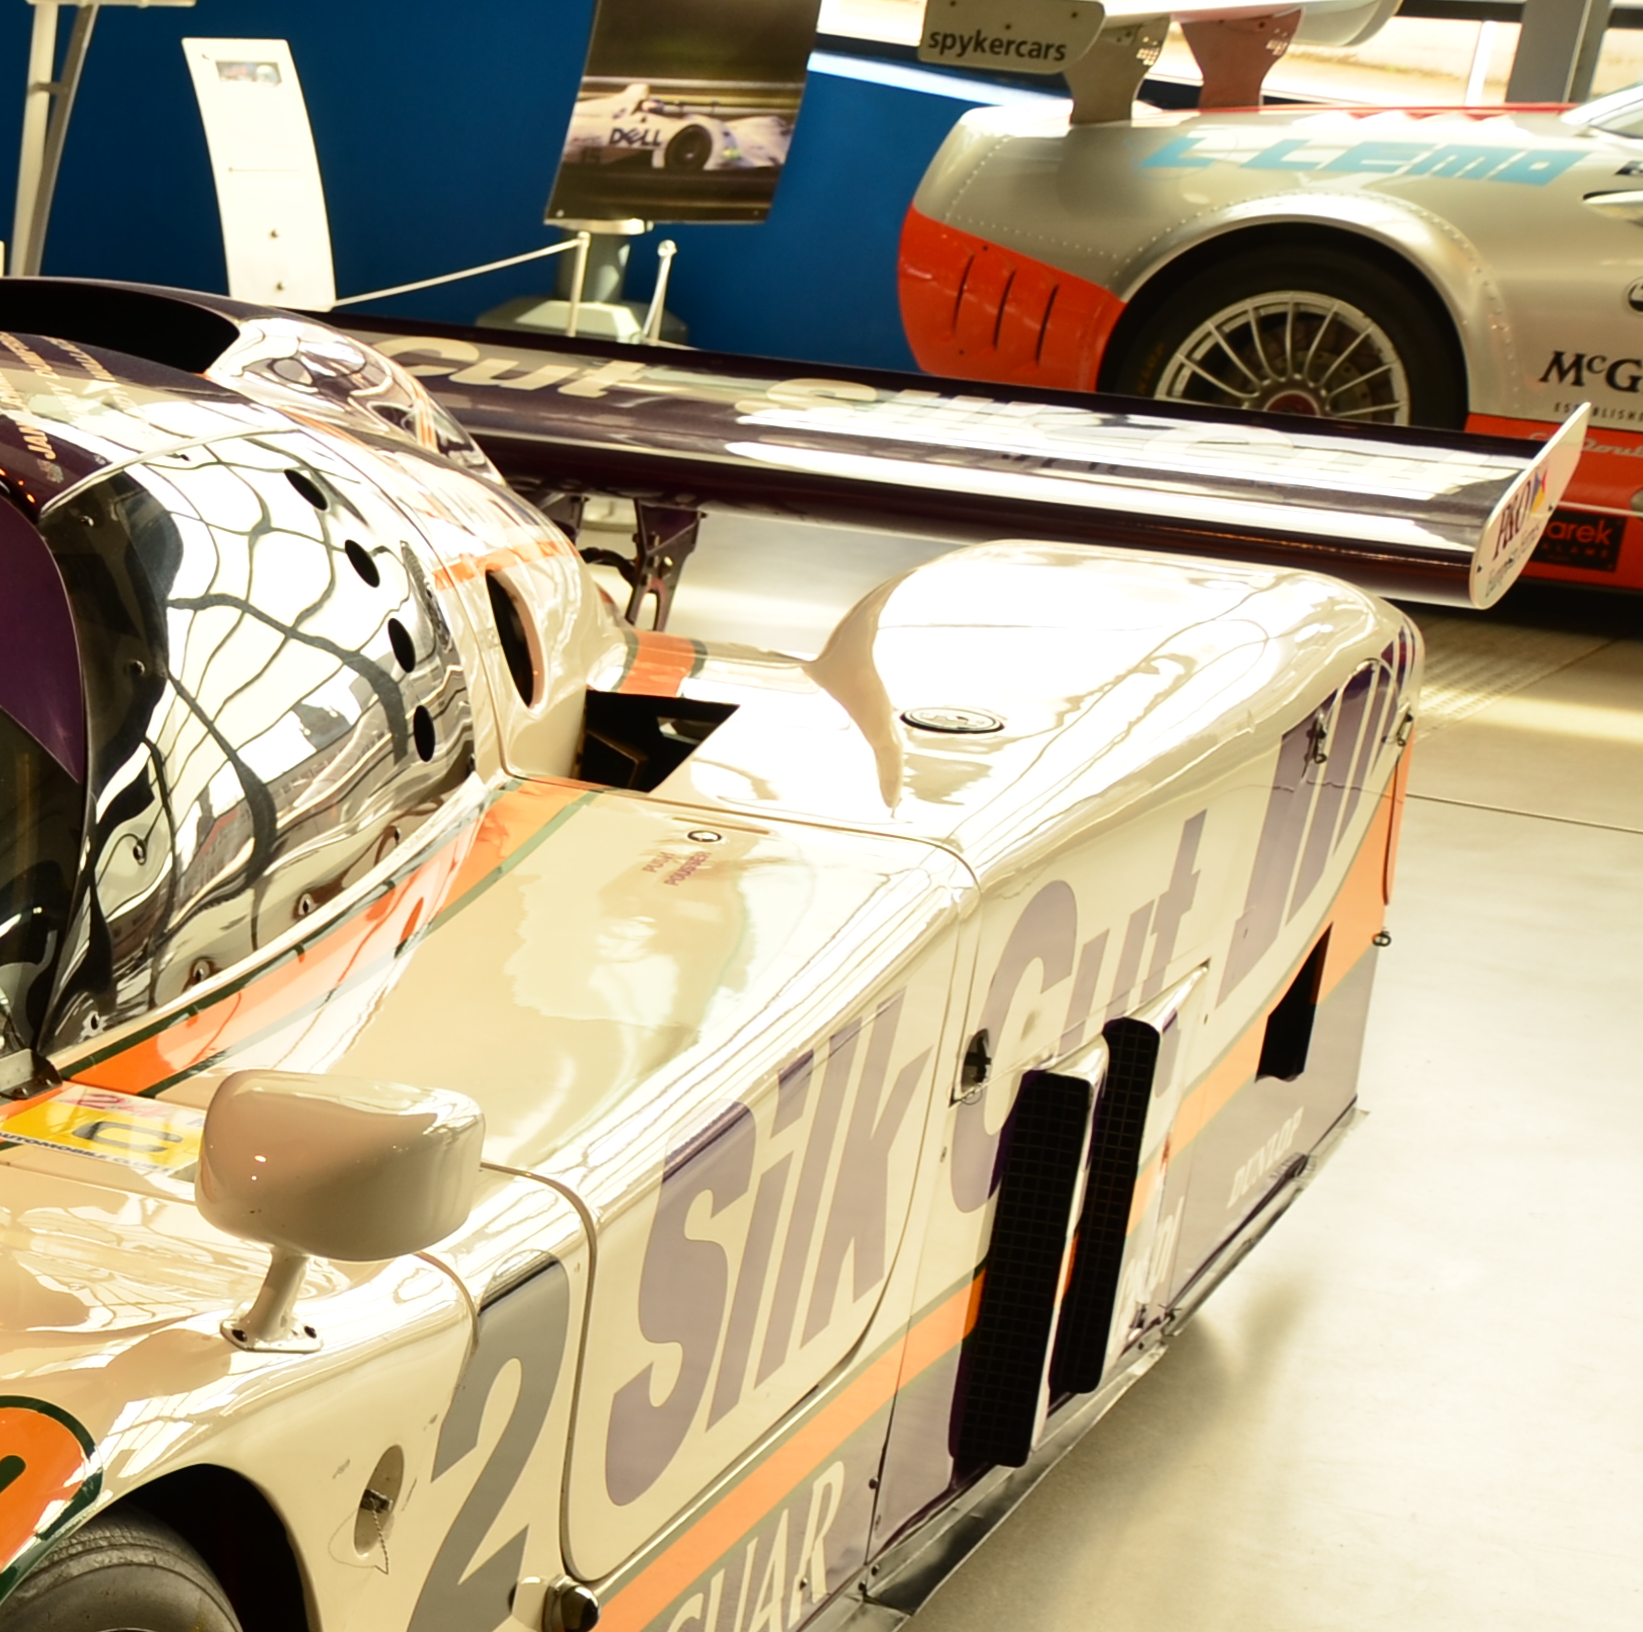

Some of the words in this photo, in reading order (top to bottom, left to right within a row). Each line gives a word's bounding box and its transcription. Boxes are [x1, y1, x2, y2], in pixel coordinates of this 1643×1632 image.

[928, 29, 1067, 62] spykercars
[610, 128, 662, 146] DELL
[1546, 518, 1612, 546] arek
[604, 985, 934, 1507] Silk
